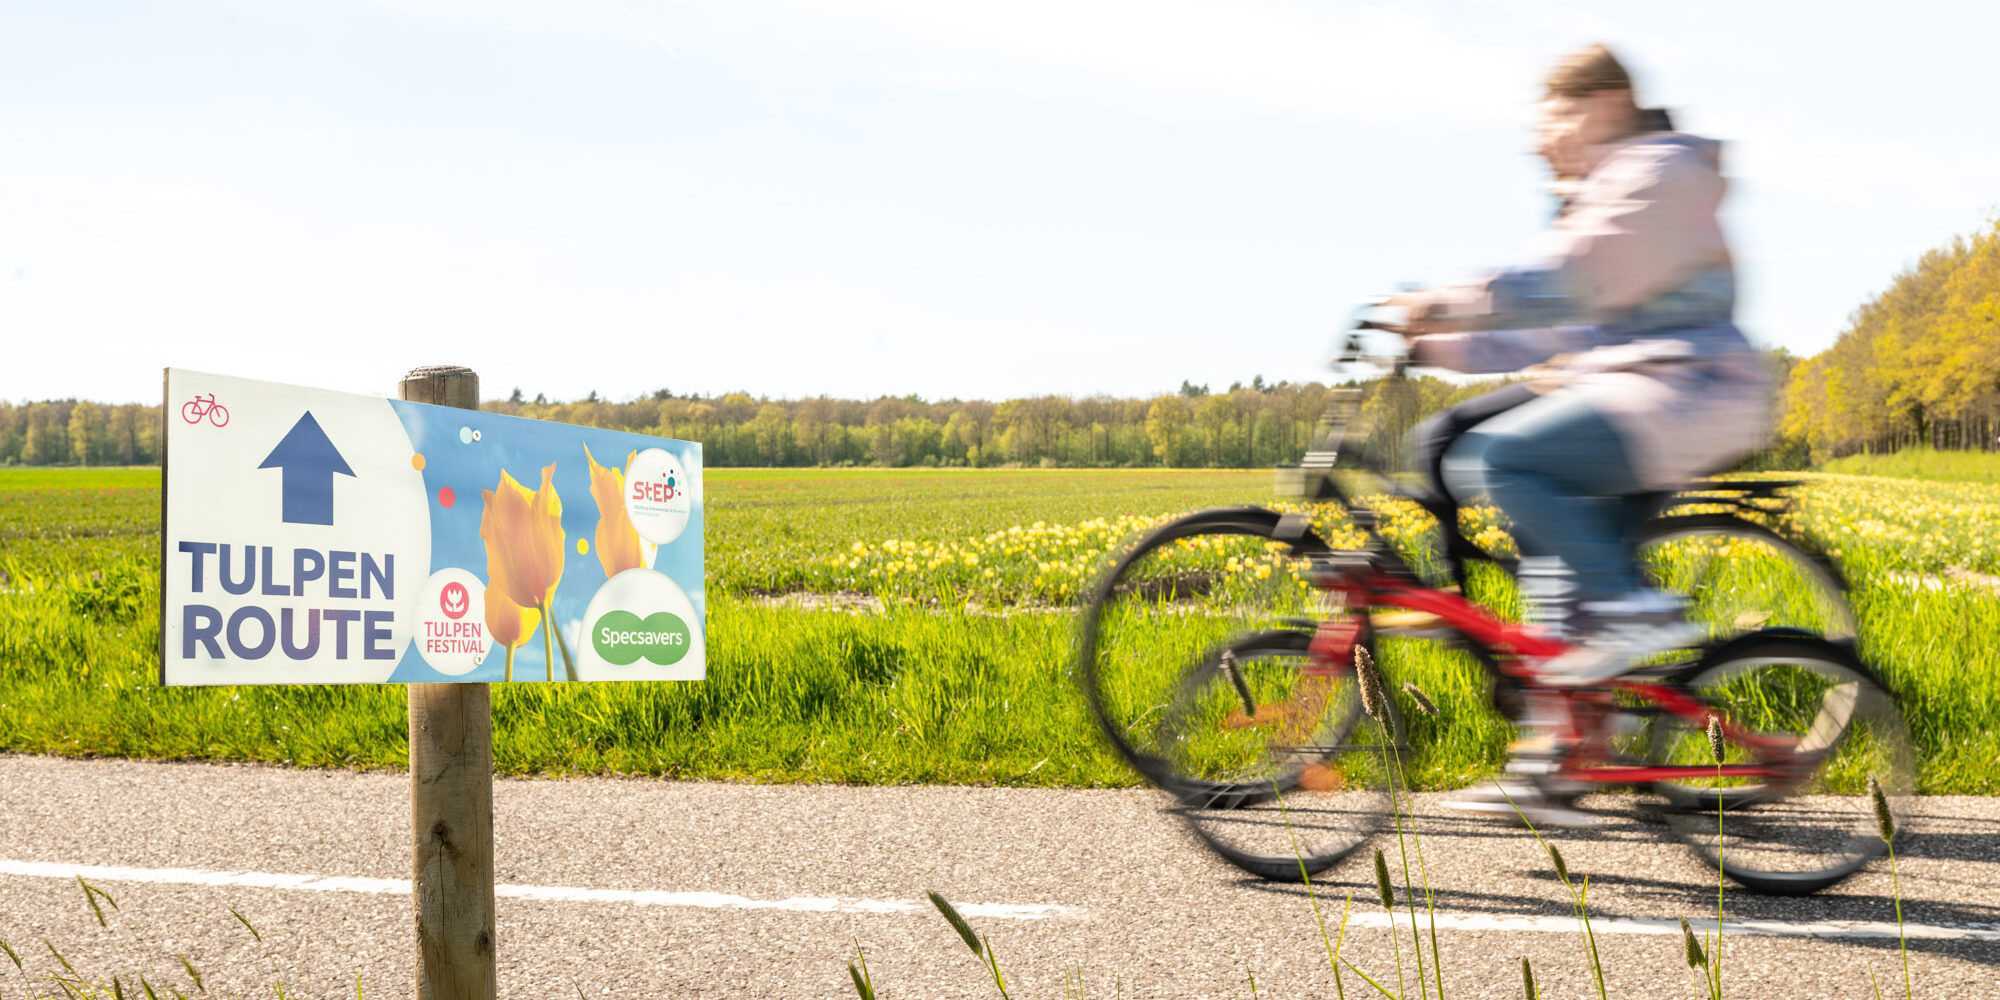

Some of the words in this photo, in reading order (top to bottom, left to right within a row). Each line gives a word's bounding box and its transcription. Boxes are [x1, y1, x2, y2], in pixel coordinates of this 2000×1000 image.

[178, 540, 395, 600] TULPEN
[182, 604, 396, 661] ROUTE
[424, 621, 481, 638] TULPEN
[601, 627, 683, 648] Specsavers
[427, 639, 485, 654] FESTIVAL
